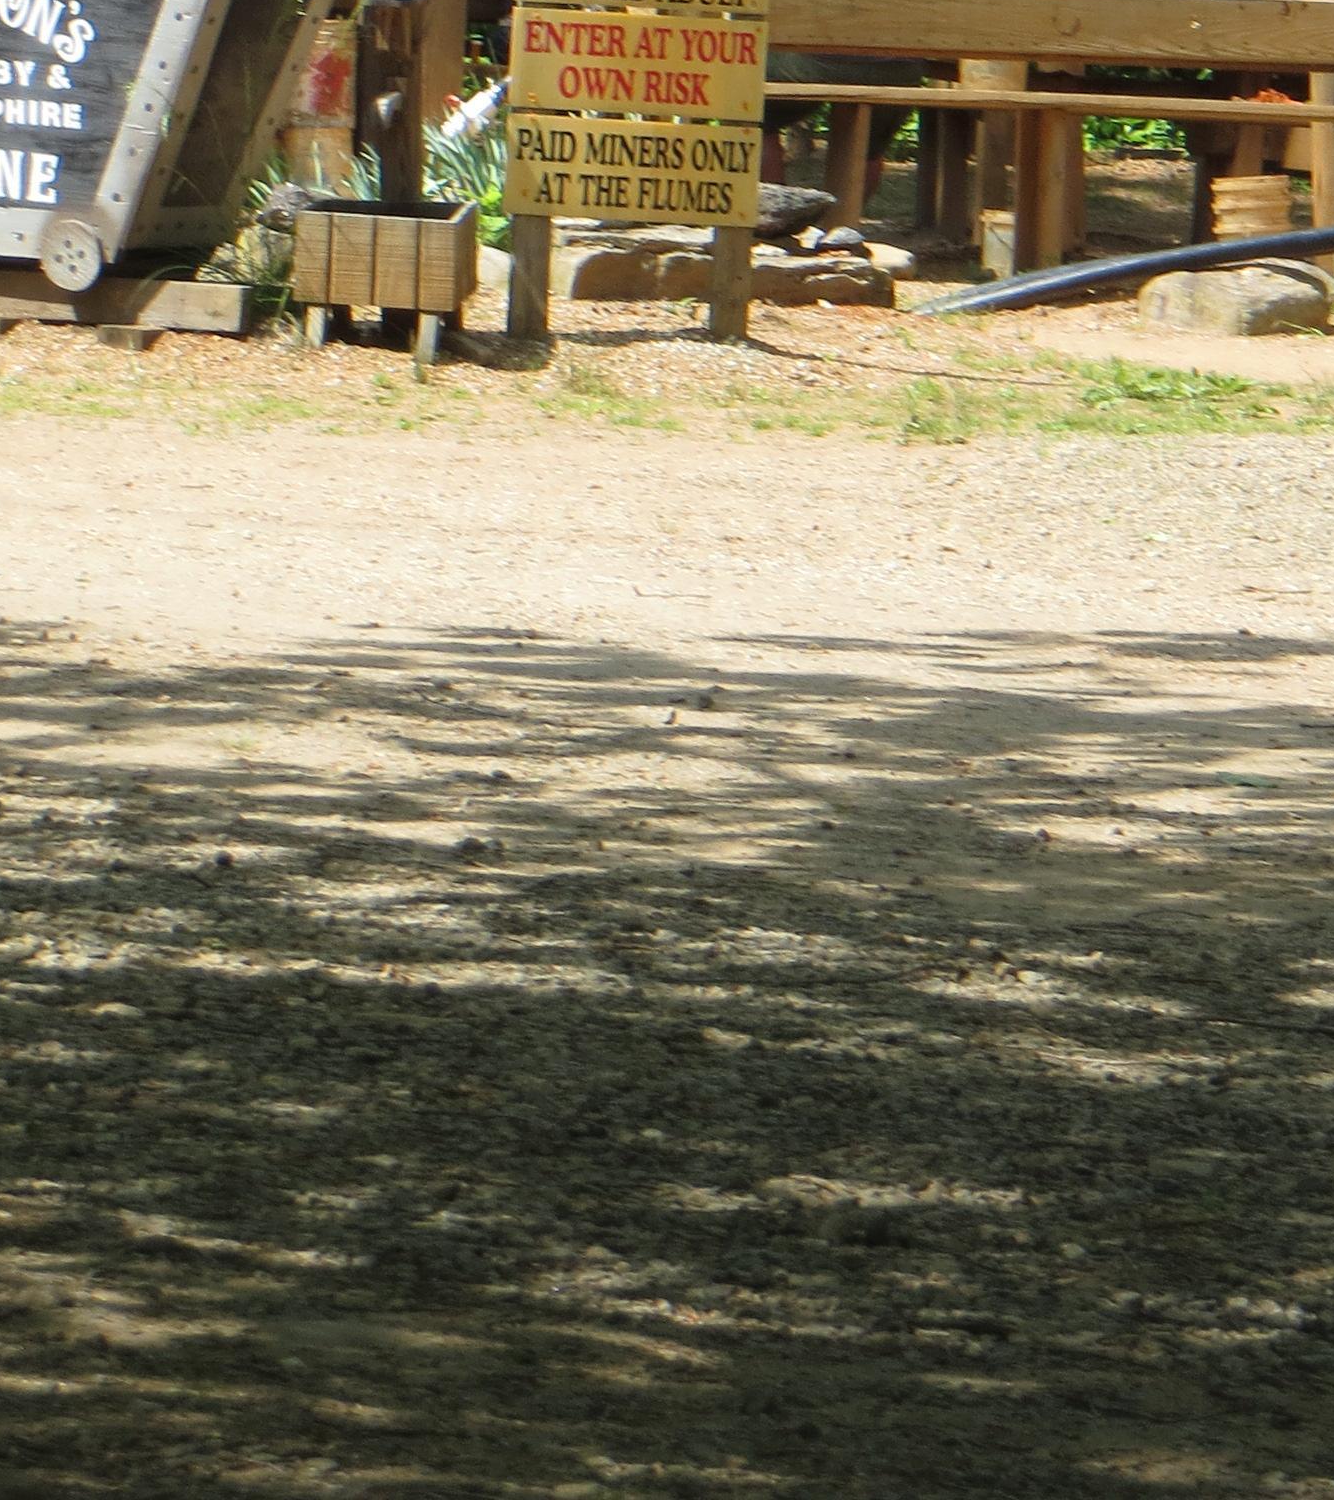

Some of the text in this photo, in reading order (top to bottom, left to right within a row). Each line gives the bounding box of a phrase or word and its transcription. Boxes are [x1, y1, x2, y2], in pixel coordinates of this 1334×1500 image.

[524, 19, 758, 65] ENTER AT YOUR
[46, 64, 72, 90] &
[558, 65, 709, 106] OWN RISK
[516, 128, 756, 174] PAID MINERS ONLY
[534, 171, 734, 214] AT THE FLUMES
